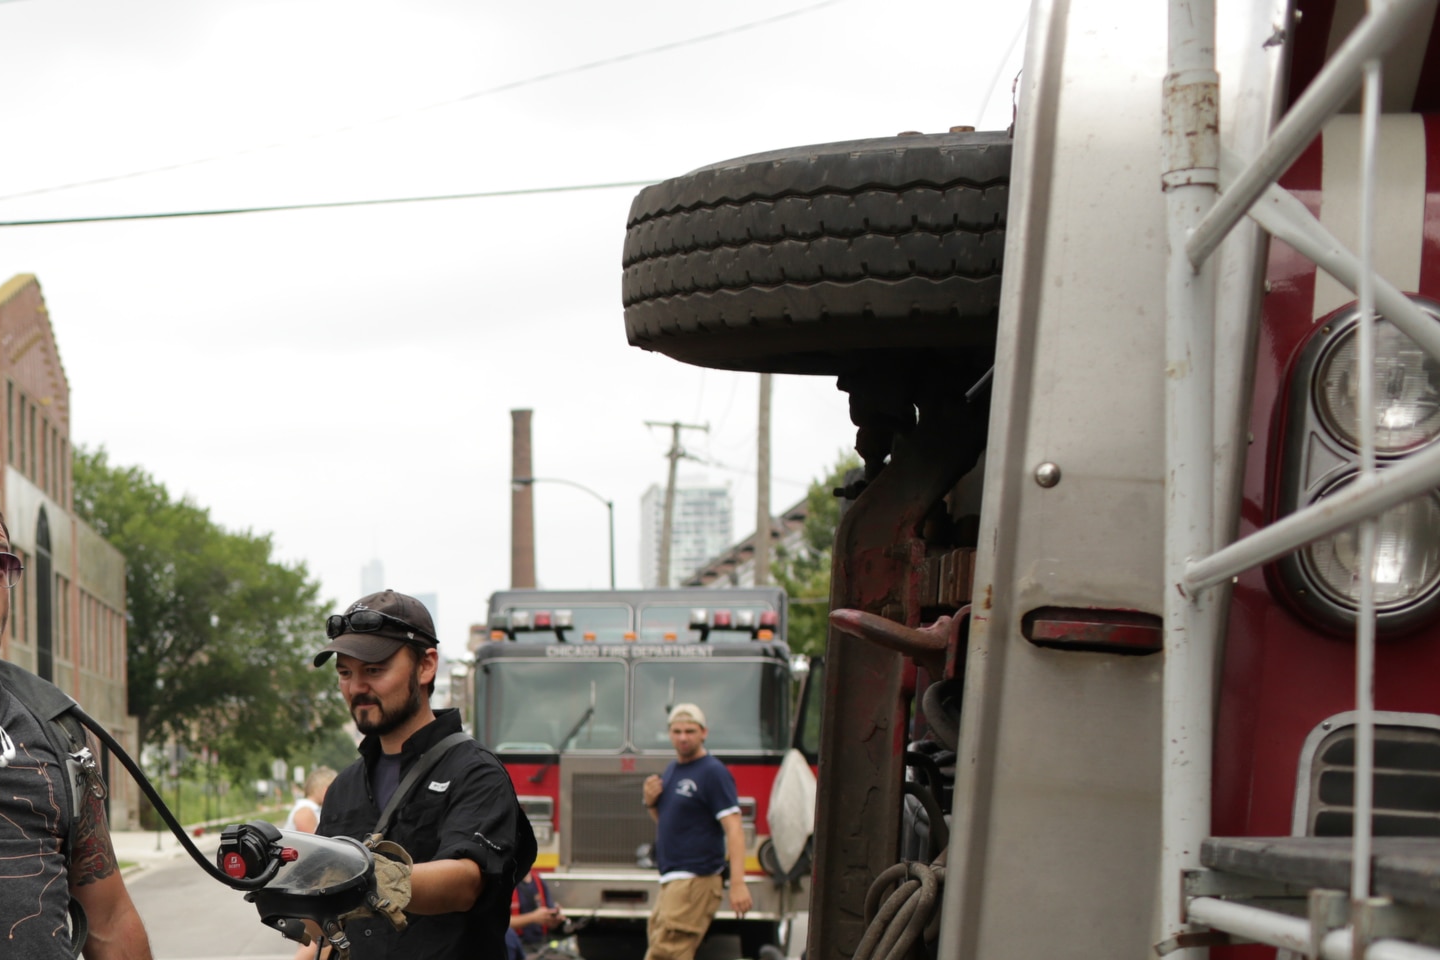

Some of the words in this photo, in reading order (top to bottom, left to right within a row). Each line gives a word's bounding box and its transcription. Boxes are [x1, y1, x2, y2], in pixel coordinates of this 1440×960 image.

[545, 645, 600, 657] CHICAGO
[601, 645, 629, 657] FIRE
[630, 645, 715, 657] DEPARTMENT
